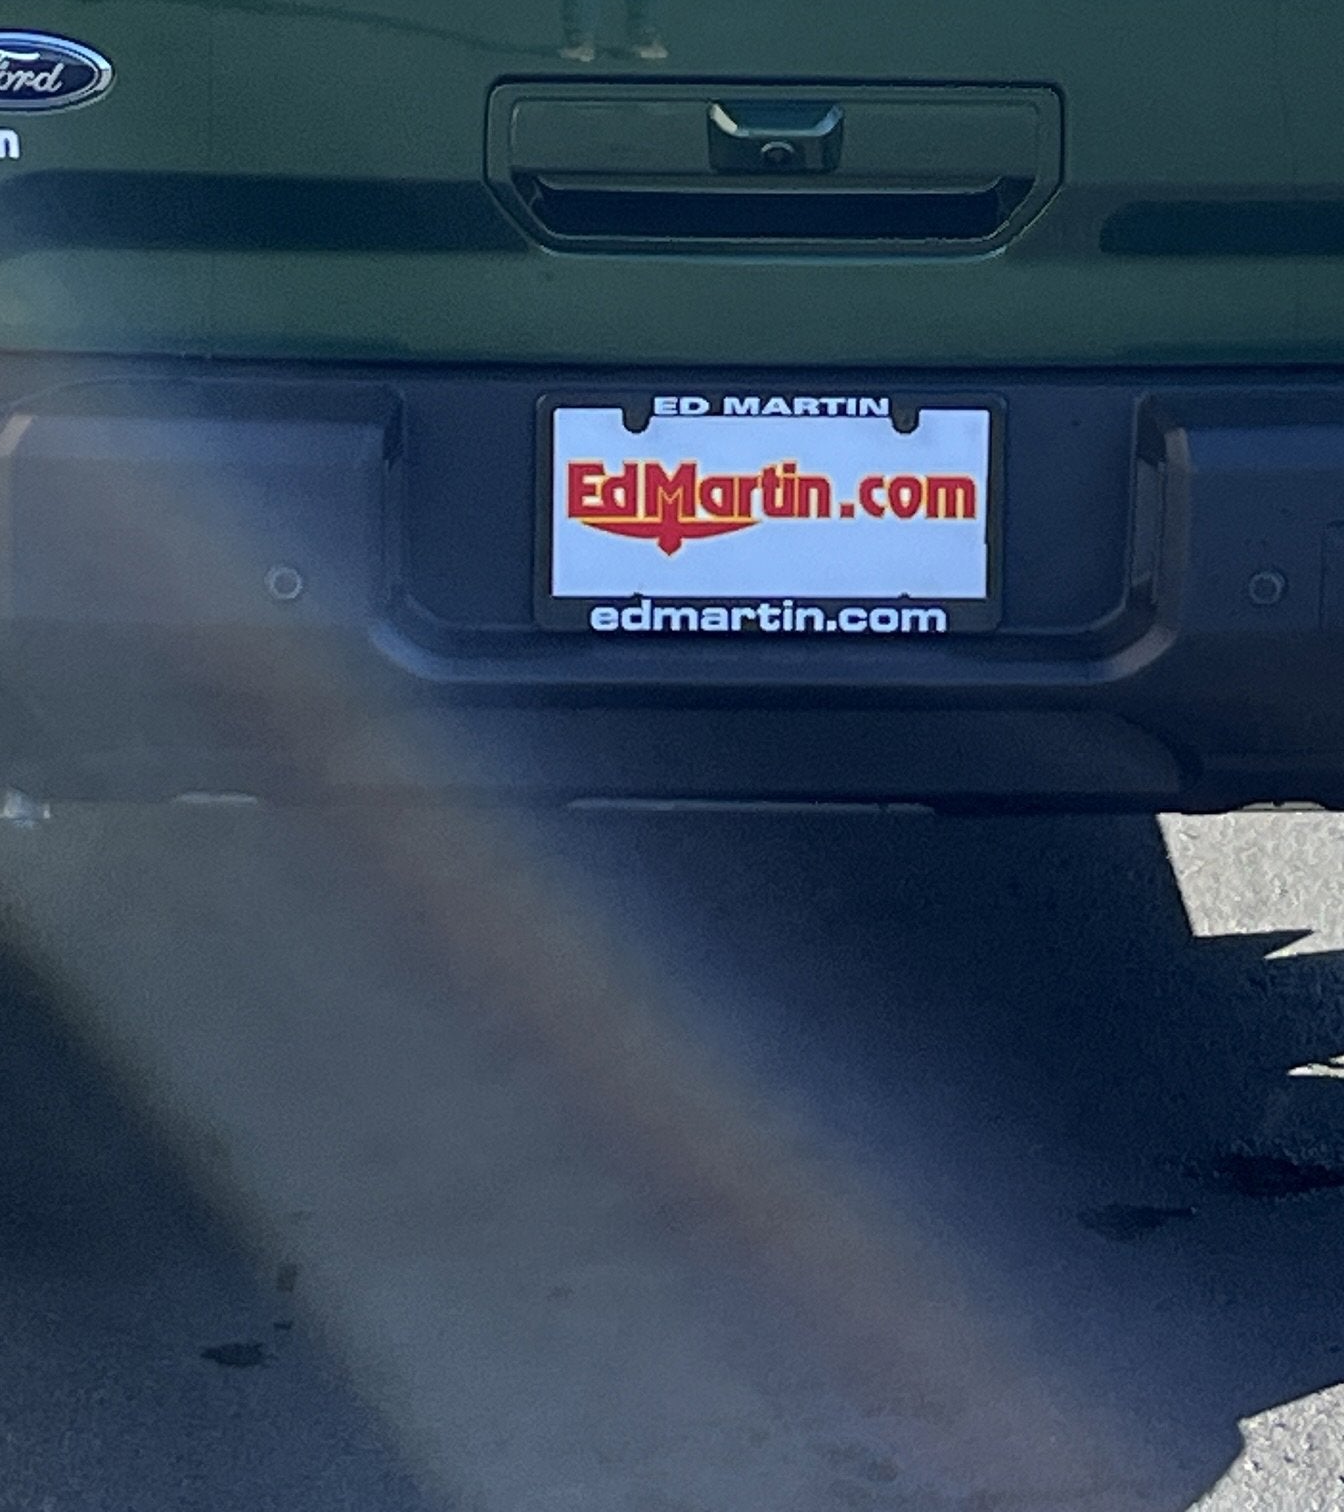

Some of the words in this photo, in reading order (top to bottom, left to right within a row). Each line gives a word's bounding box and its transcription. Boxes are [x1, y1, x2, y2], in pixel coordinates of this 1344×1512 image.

[653, 396, 710, 417] ED
[722, 396, 890, 417] MARTIN
[567, 460, 978, 519] EdMartin.com
[590, 598, 947, 633] edmartin.com
